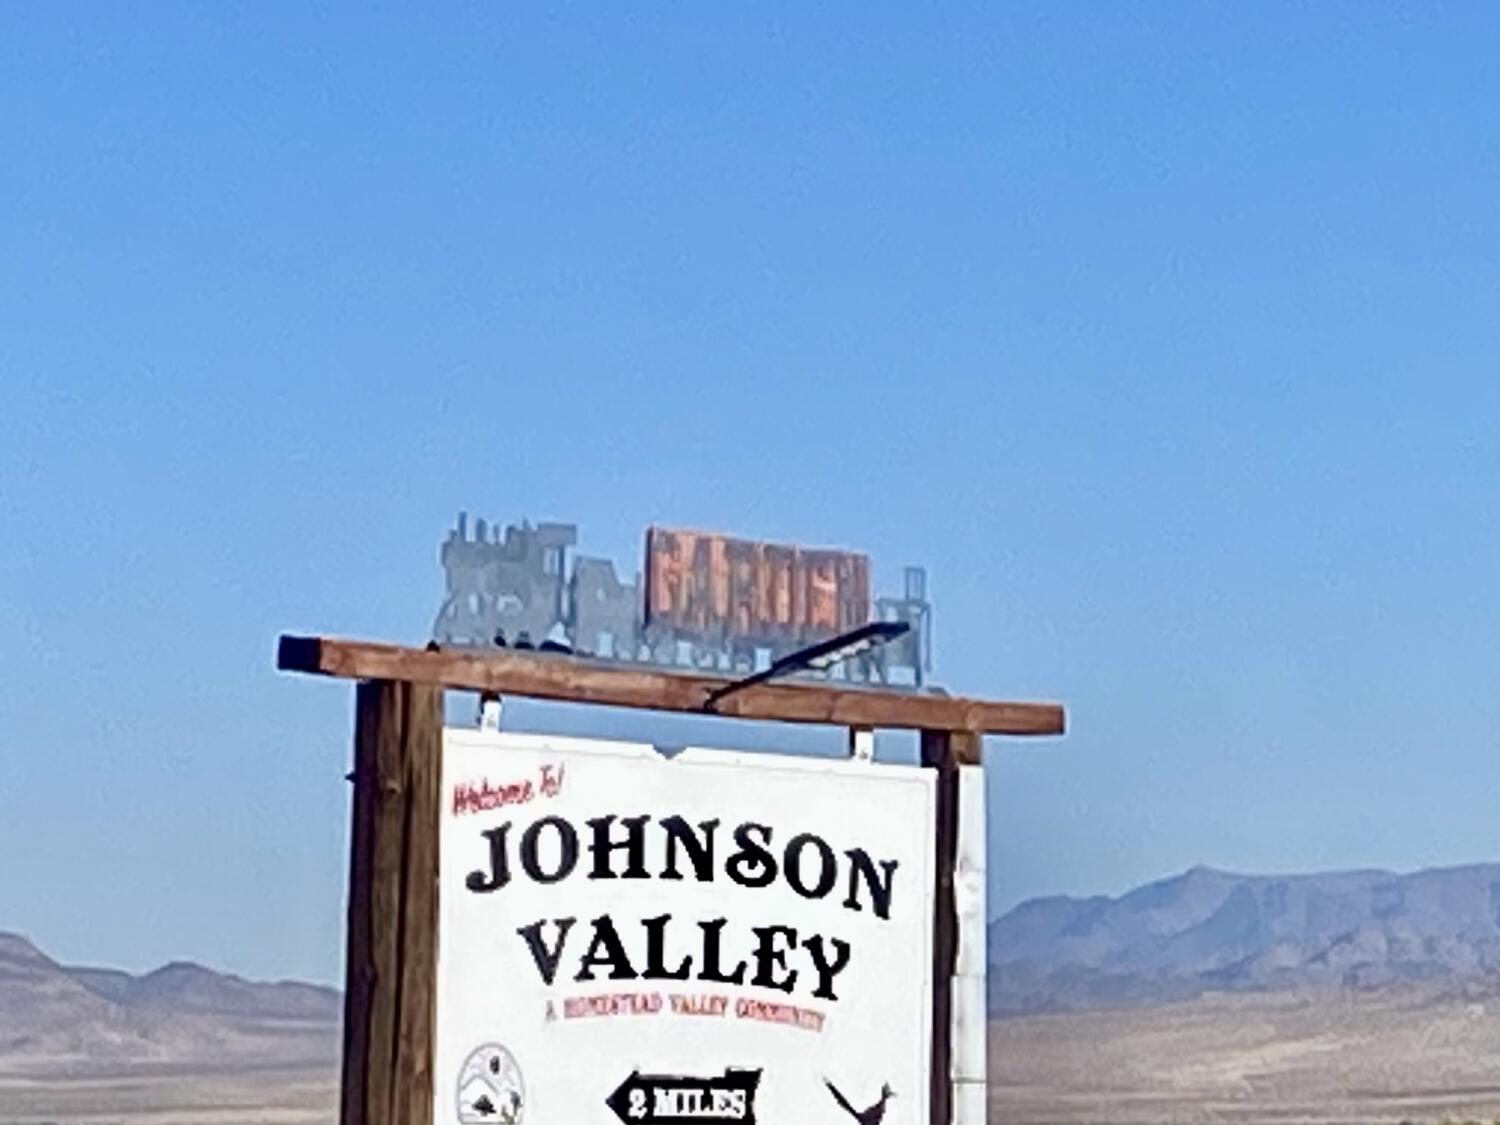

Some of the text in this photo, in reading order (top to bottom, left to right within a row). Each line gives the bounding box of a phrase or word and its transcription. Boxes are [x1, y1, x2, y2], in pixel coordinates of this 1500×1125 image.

[465, 815, 898, 920] JOHNSON
[516, 914, 851, 1001] VALLEY
[670, 994, 727, 1016] VALLEY
[628, 1087, 746, 1119] 2 MILES
